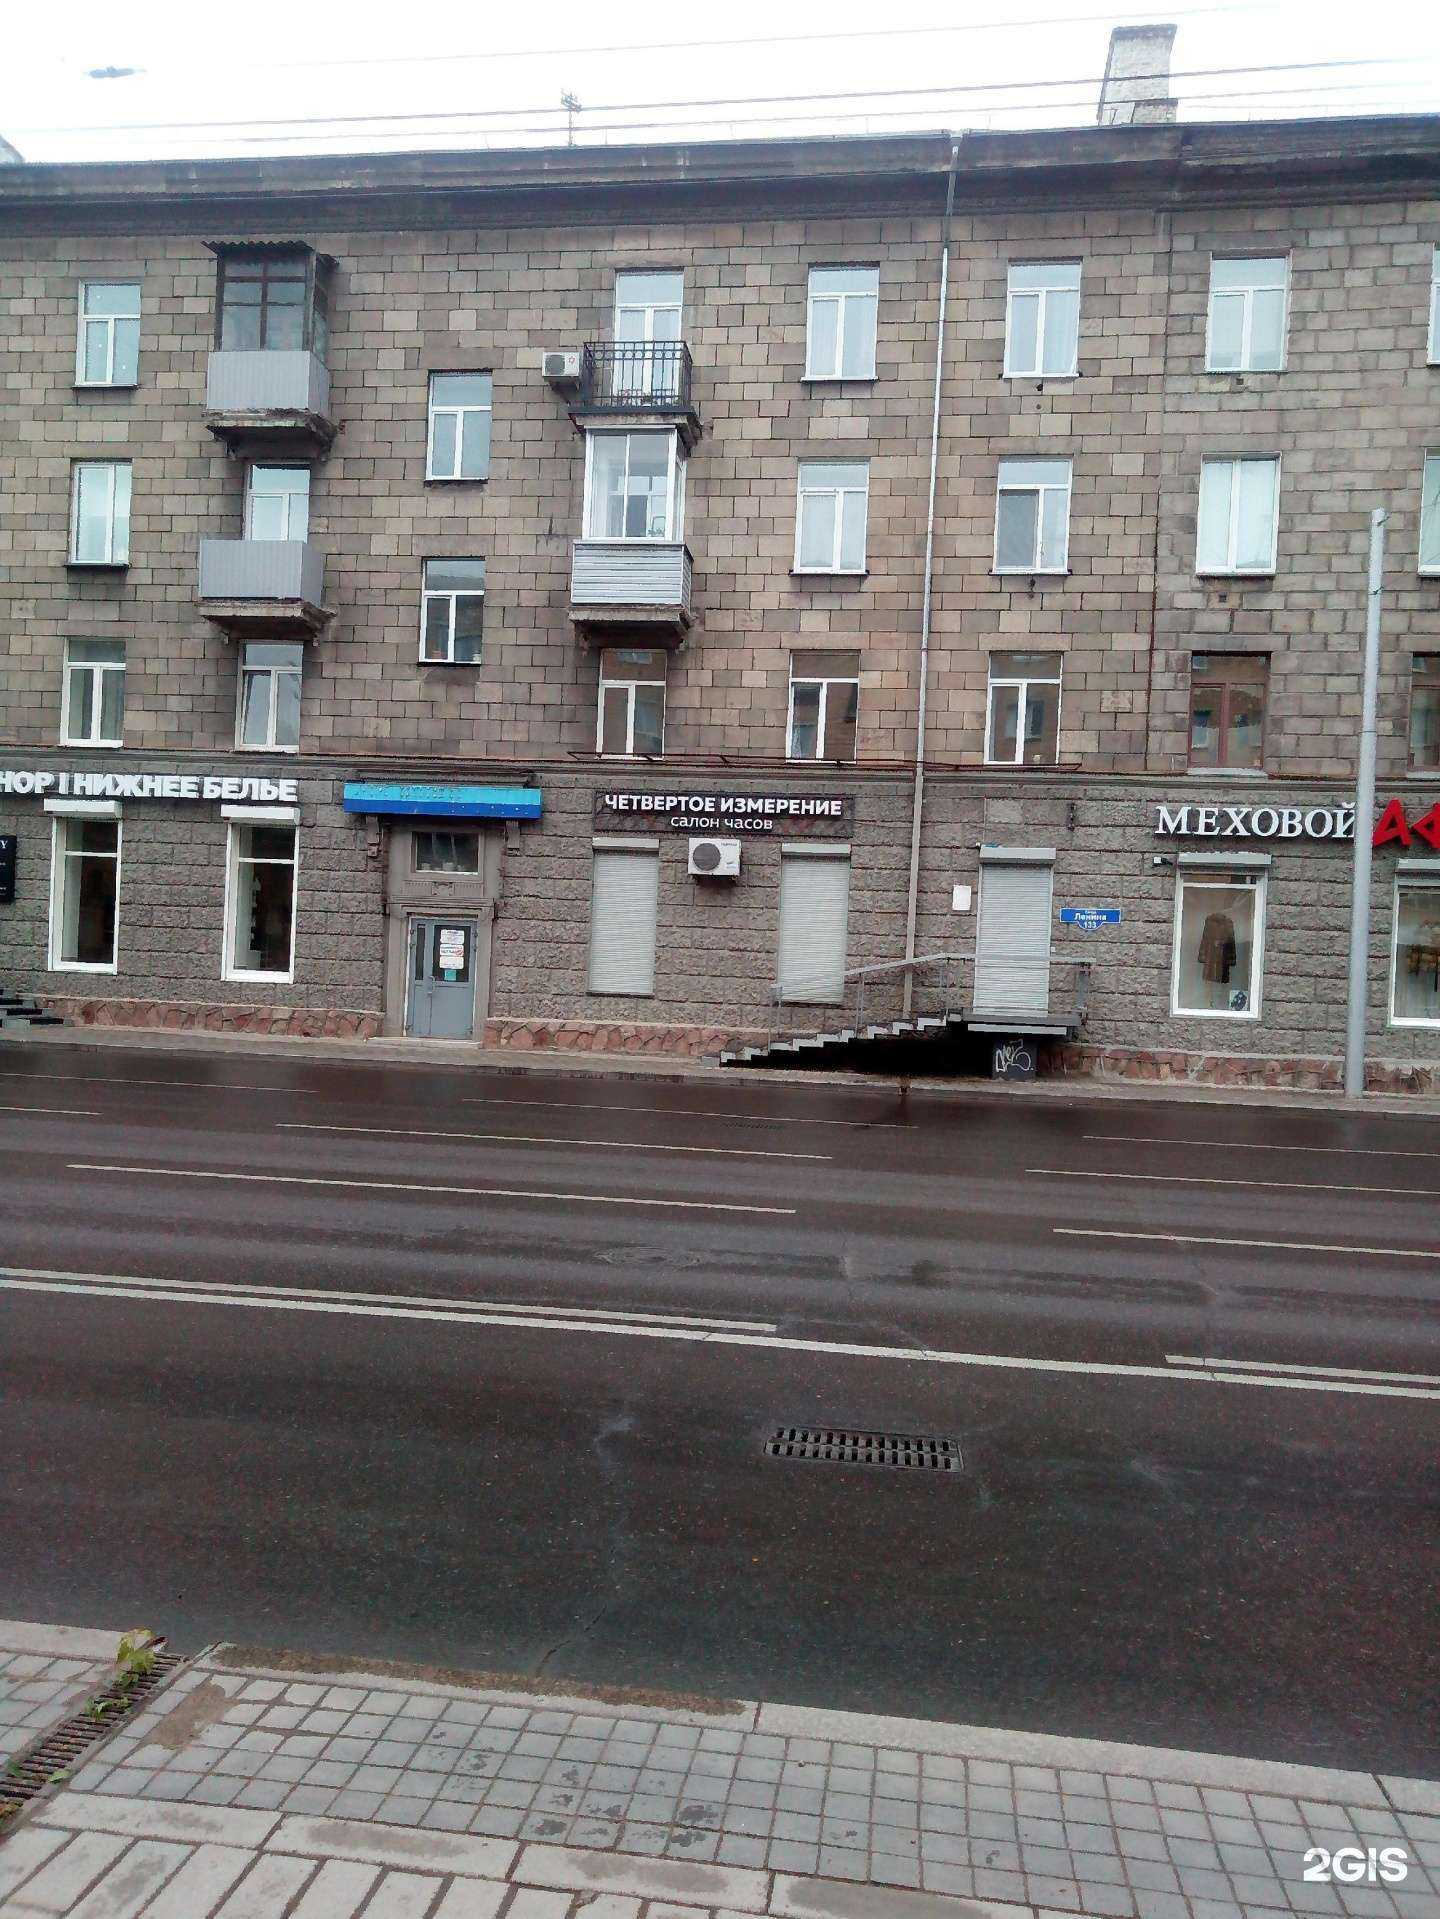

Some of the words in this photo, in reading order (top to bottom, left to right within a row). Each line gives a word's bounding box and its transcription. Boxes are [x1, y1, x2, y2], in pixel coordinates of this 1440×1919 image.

[73, 772, 200, 799] НИЖНЕЕ
[202, 776, 299, 802] БЕЛЬЕ
[604, 794, 716, 813] ЧЕТВЕРТОЕ
[719, 797, 842, 816] ИЗМЕРЕНИЕ
[670, 815, 721, 829] салон
[723, 817, 774, 831] часов
[1074, 912, 1107, 921] Ленина
